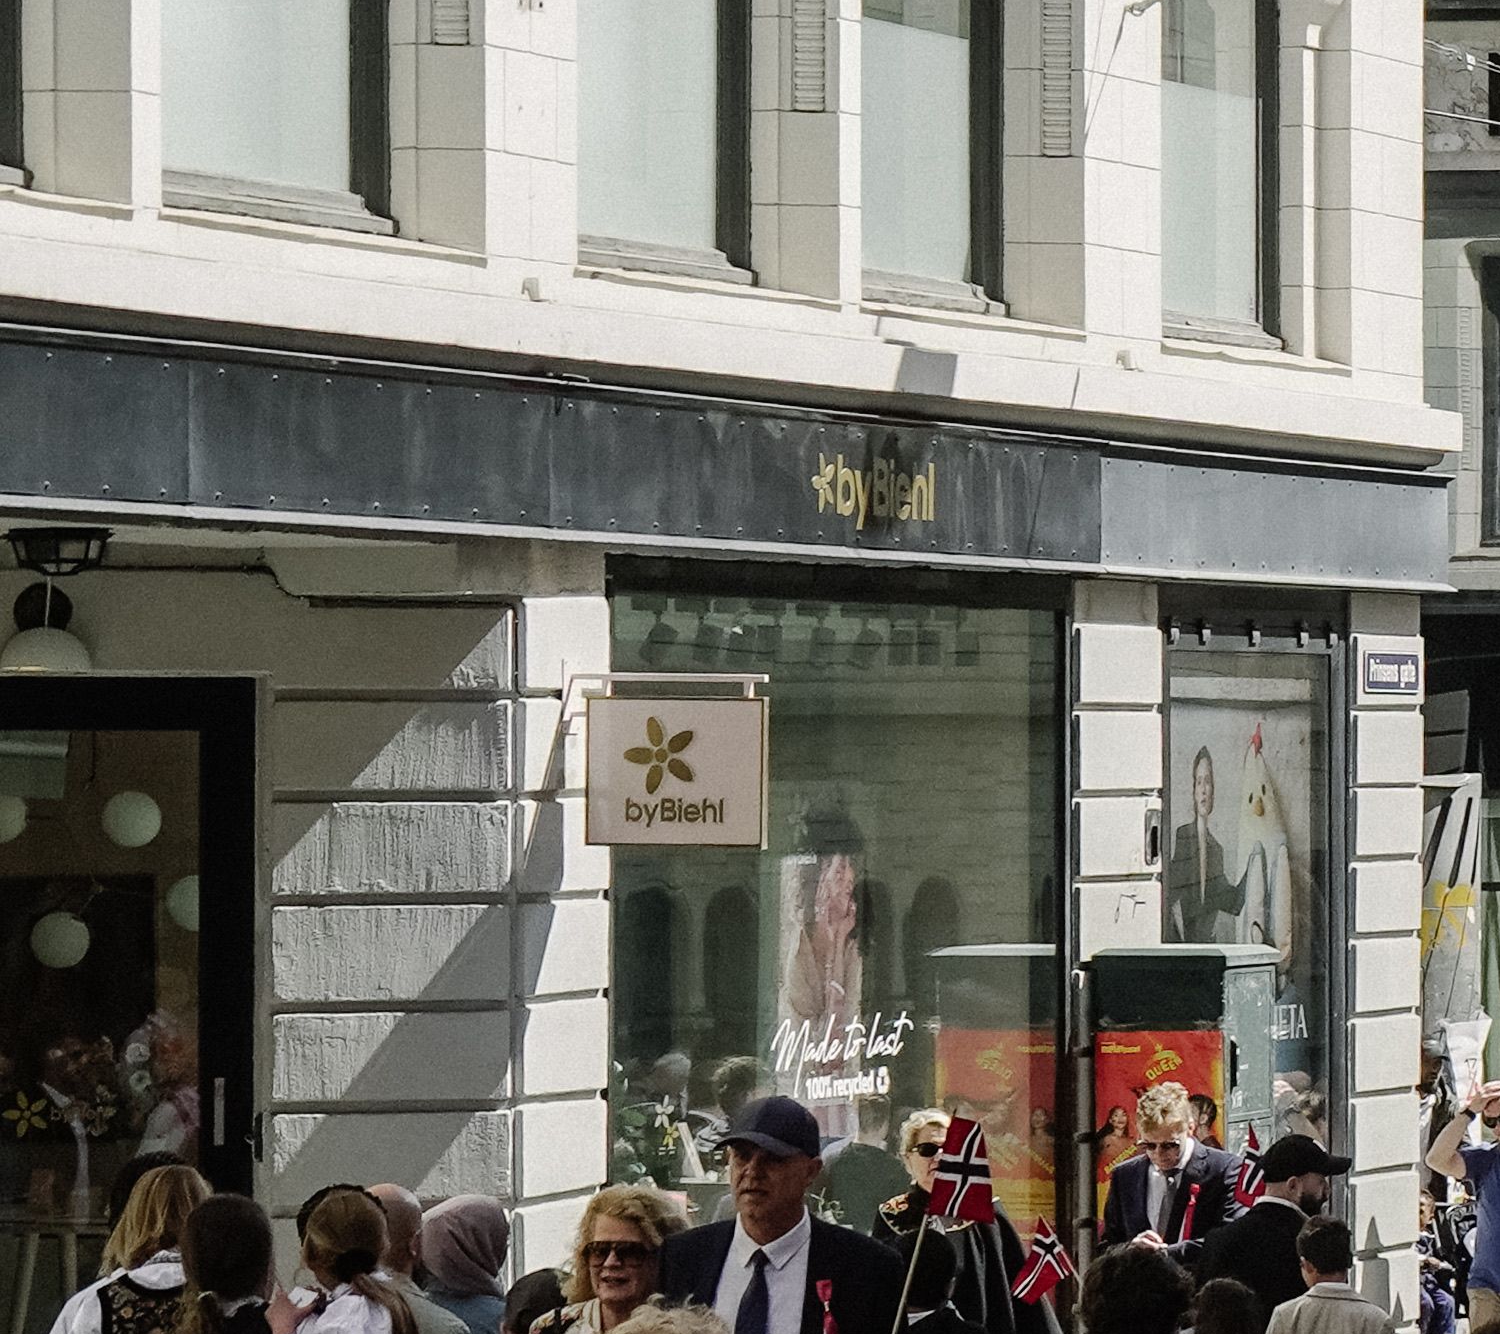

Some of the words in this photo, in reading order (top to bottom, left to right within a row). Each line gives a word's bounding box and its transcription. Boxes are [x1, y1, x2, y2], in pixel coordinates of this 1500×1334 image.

[624, 797, 725, 828] byBiehl
[770, 1013, 843, 1099] Made
[843, 1015, 867, 1061] to
[866, 1010, 914, 1059] last
